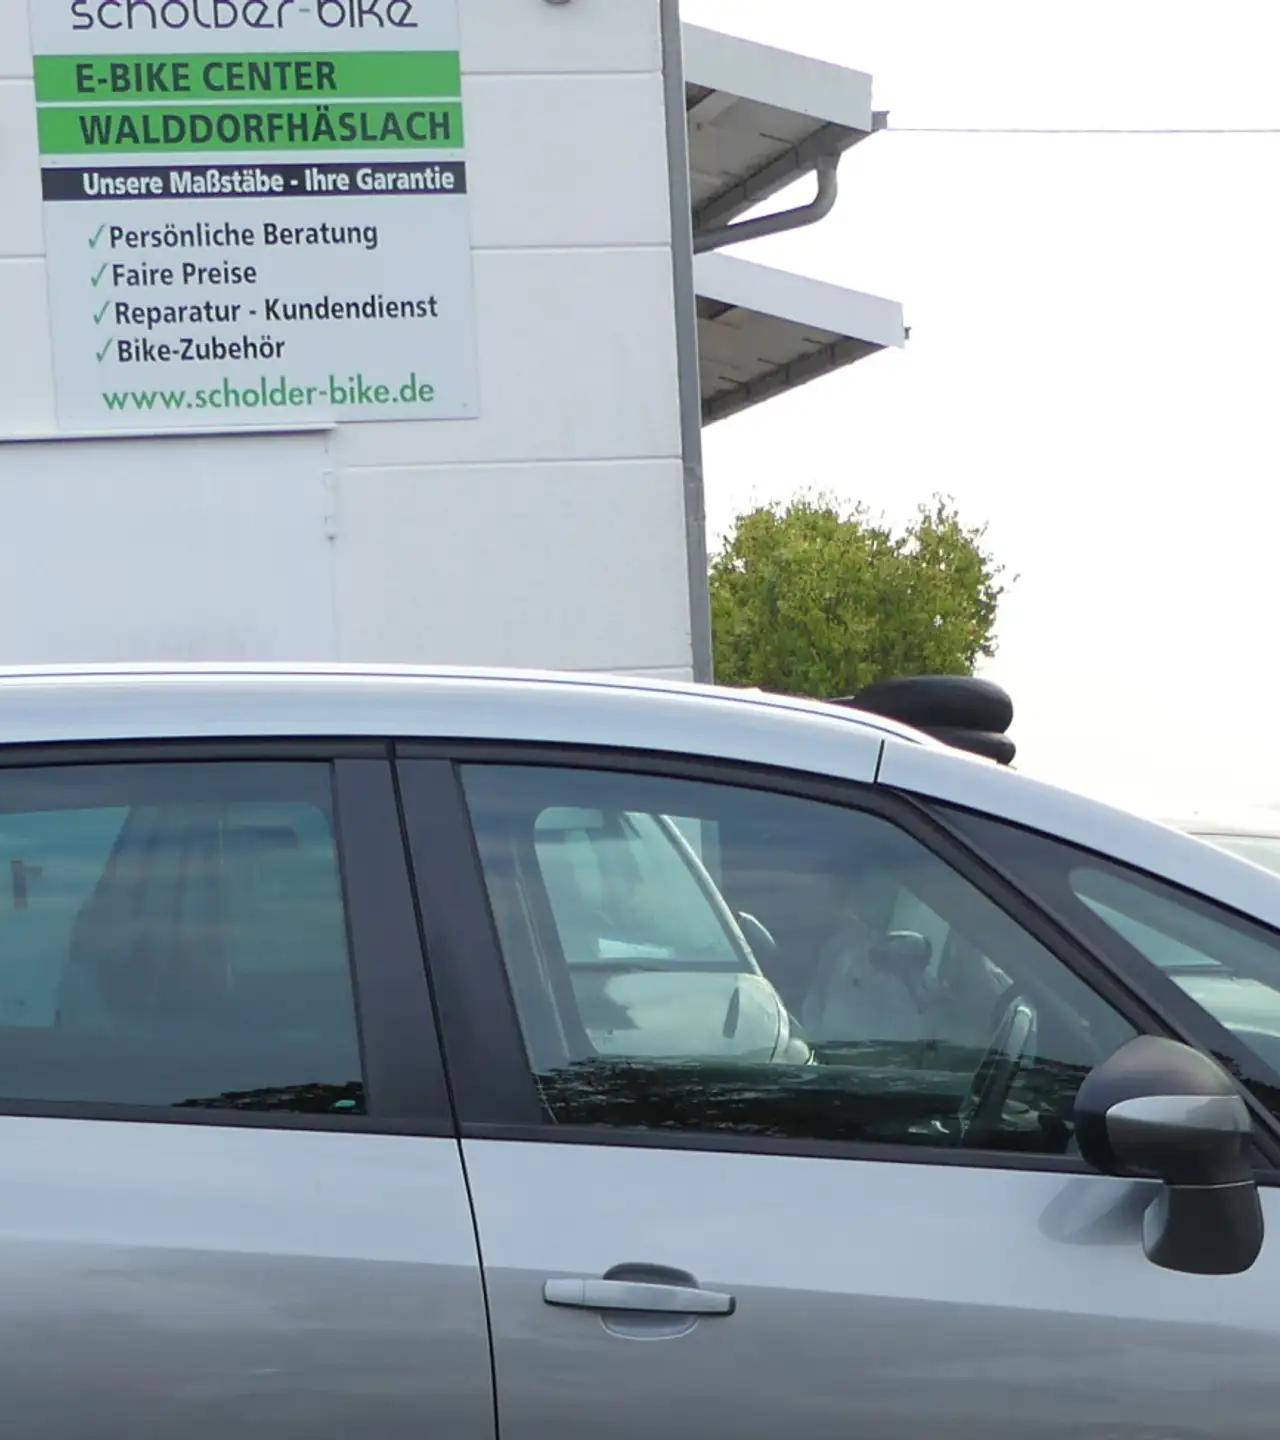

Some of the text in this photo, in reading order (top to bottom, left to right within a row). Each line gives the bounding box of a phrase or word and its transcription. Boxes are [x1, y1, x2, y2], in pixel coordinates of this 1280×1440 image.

[75, 60, 338, 93] E-BIKE CENTER
[79, 105, 451, 145] WALDDORFHÄSLACH
[83, 172, 163, 195] Unsere
[170, 169, 284, 193] Maßstäbe
[305, 167, 350, 191] Ihre
[356, 167, 455, 190] Garantie
[110, 222, 378, 249] Persönliche Beratung
[112, 260, 257, 286] Faire Preise
[115, 300, 241, 329] Reparatur
[264, 295, 439, 321] Kundendienst
[117, 335, 286, 362] Bike-Zubehör
[102, 372, 435, 410] www.scholder-bike.de
